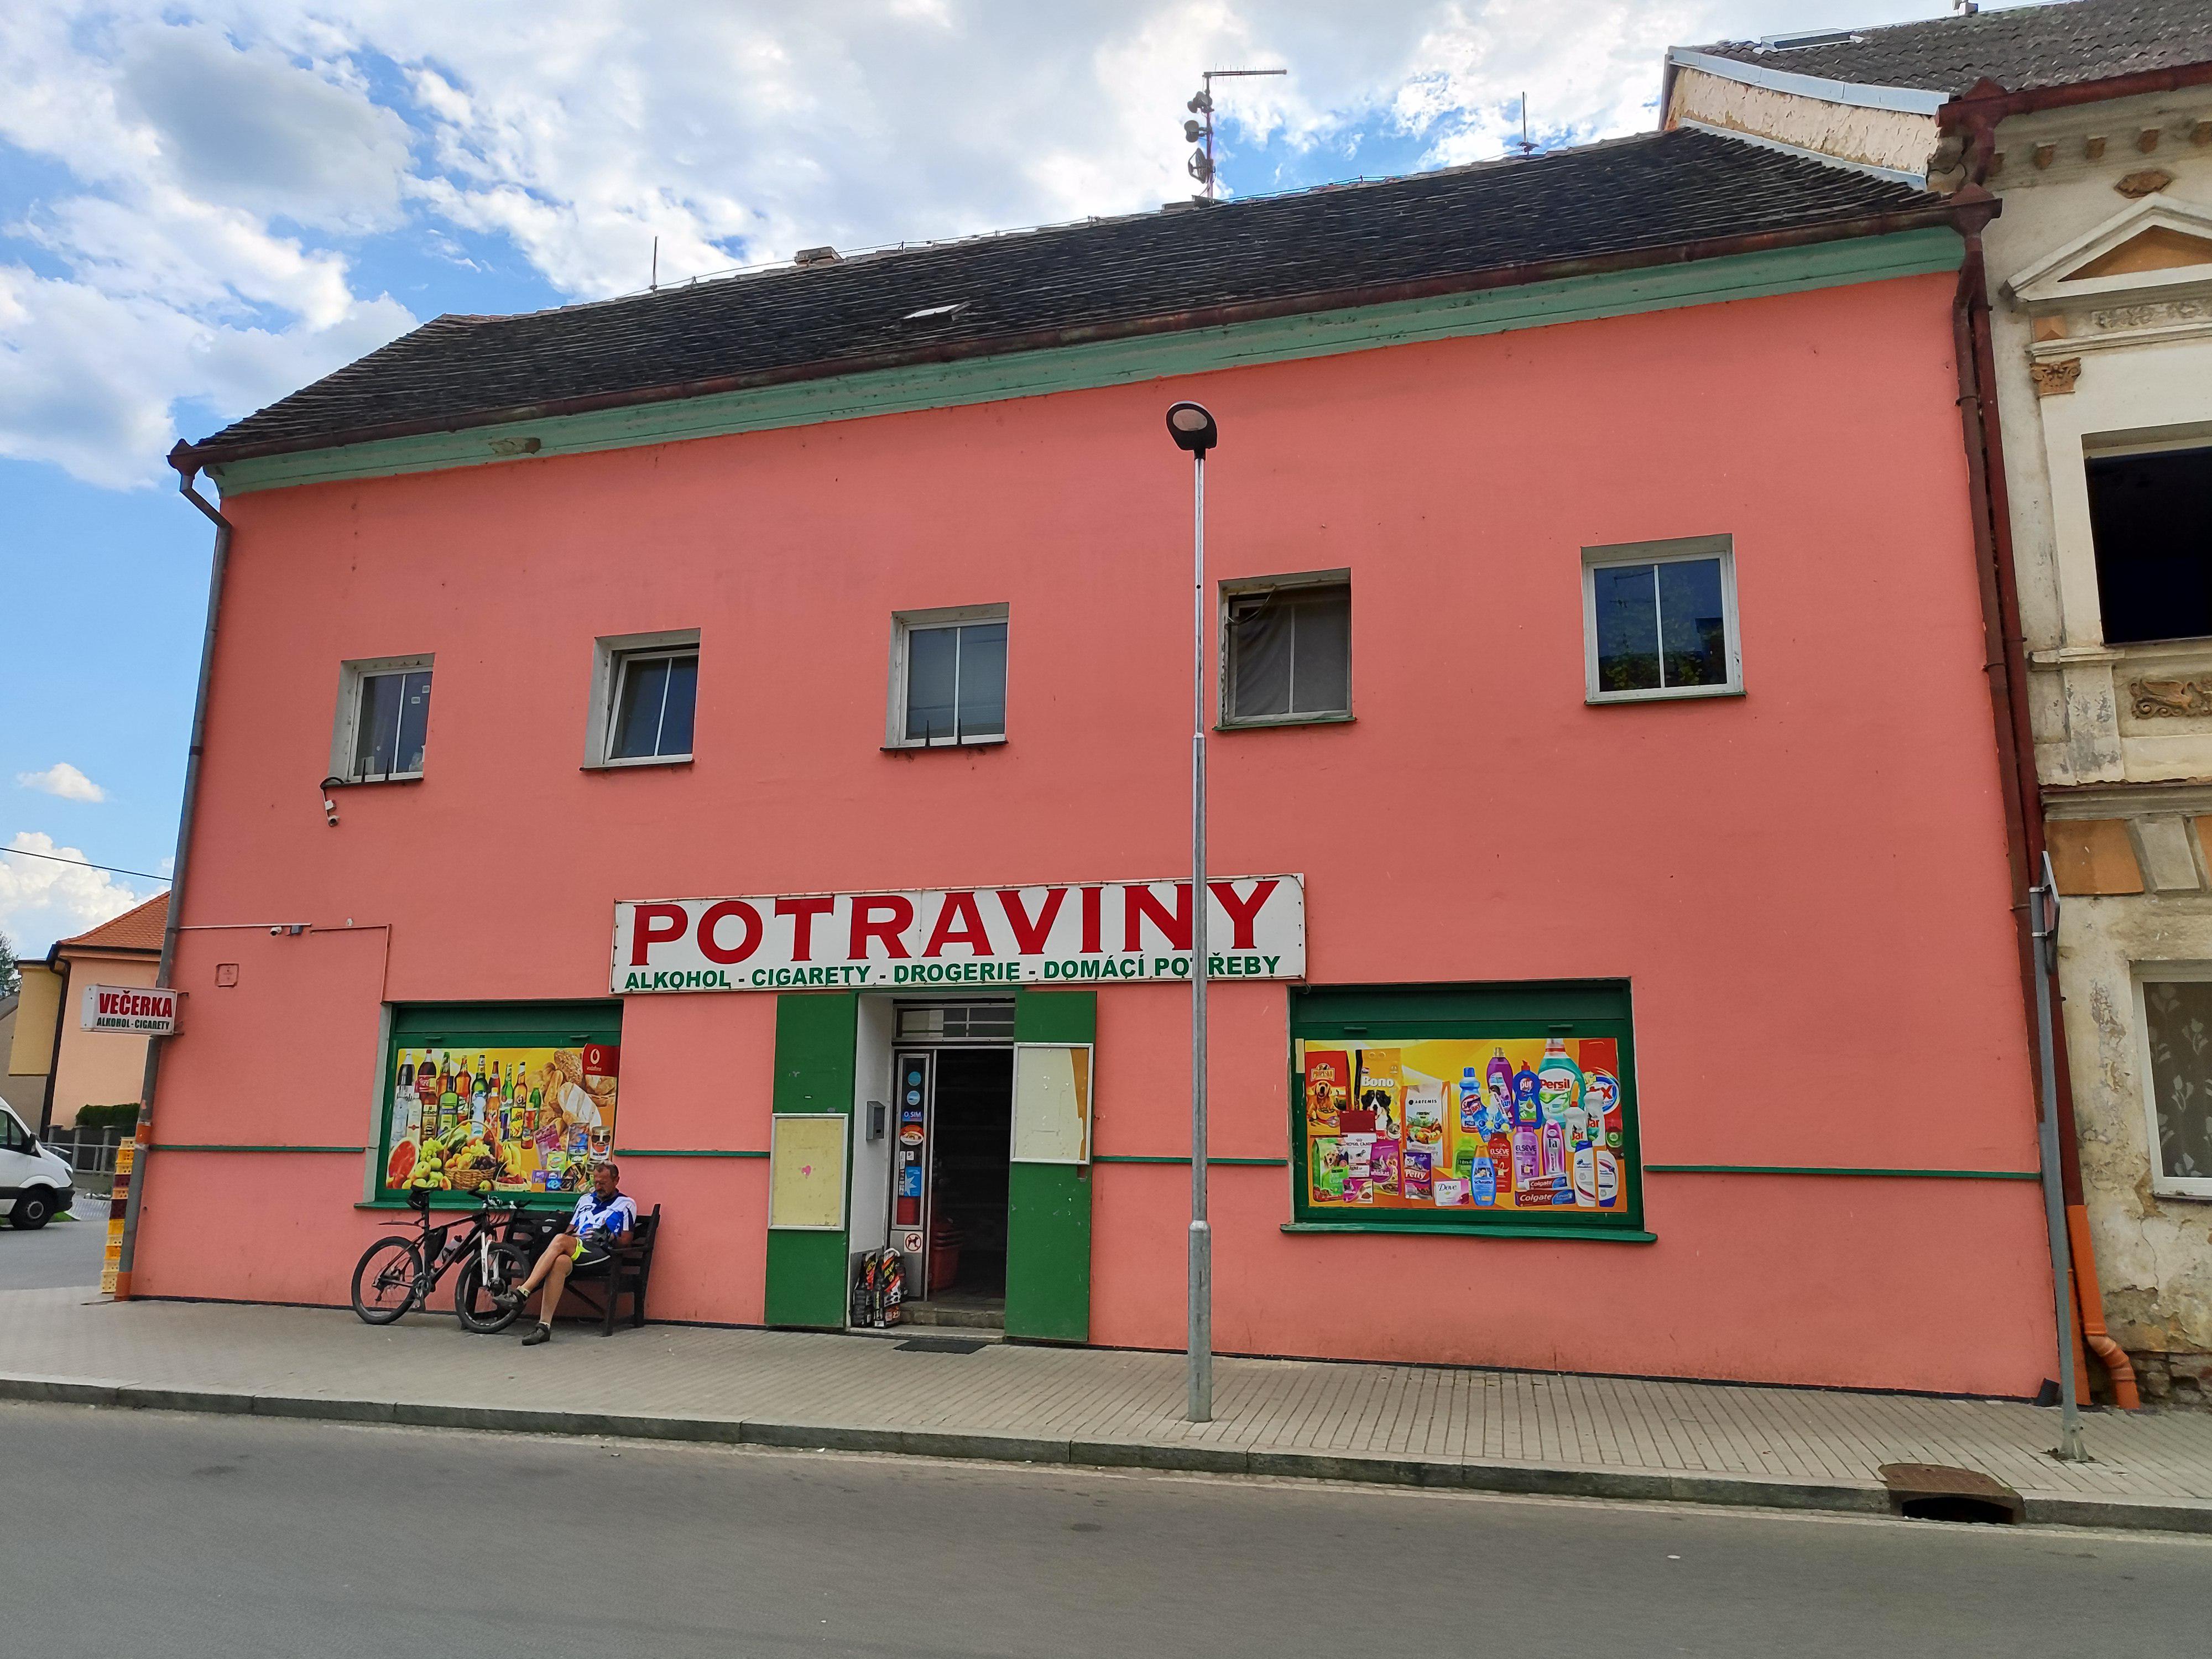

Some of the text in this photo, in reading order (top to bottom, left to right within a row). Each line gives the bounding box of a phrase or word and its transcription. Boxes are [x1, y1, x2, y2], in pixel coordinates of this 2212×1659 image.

[629, 880, 1280, 966] POTRAVINY
[625, 970, 731, 989] ALKOHOL
[752, 965, 871, 986] CIGARETY
[894, 961, 1021, 983] DROGERIE
[1044, 954, 1145, 979] DOMÁCÍ
[1155, 952, 1281, 977] POŘEBY
[99, 990, 173, 1018] VEČERKA
[96, 1017, 130, 1028] ALKOHOL
[134, 1019, 170, 1030] CIGARETY
[1360, 1076, 1394, 1087] Bono
[1540, 1078, 1571, 1089] Persil
[1519, 1194, 1553, 1203] Colgate
